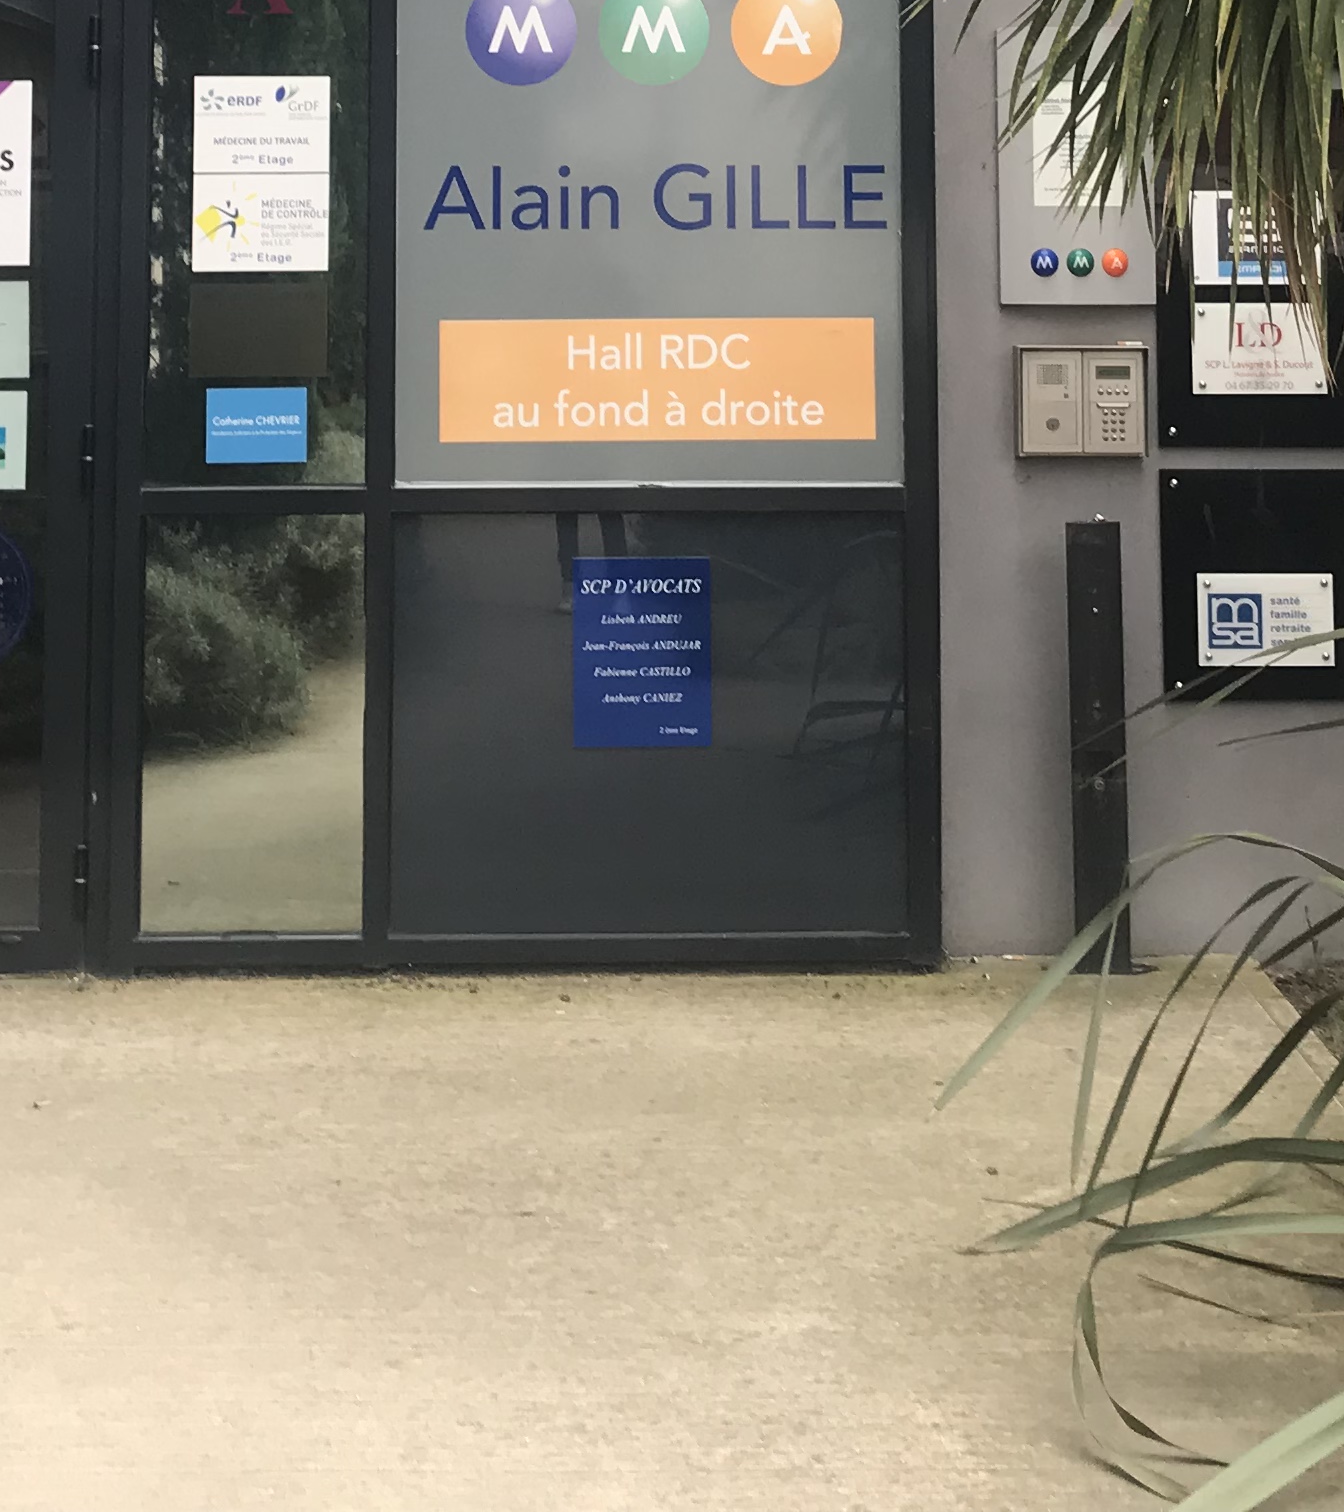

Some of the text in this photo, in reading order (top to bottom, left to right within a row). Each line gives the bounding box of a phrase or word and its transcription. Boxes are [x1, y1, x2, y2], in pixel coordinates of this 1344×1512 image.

[213, 136, 310, 146] MÉDECINE DU TRAVAIL
[258, 154, 294, 166] Etage
[423, 163, 888, 230] Alain GILLE
[261, 197, 312, 208] MÉDECINE
[261, 207, 330, 219] DE CONTRÔLE
[257, 252, 292, 264] Etage
[567, 332, 751, 370] Hall RDC
[493, 389, 825, 427] au fond à droite
[212, 415, 301, 426] Catherine CHEVRIER
[581, 578, 702, 594] SCP D'AVOCATS
[1270, 596, 1300, 606] santé
[637, 614, 683, 624] ANDREU
[1270, 609, 1308, 619] famille
[1270, 623, 1312, 633] retraite
[652, 640, 702, 650] ANDUJAR
[640, 666, 692, 677] CASTILLO
